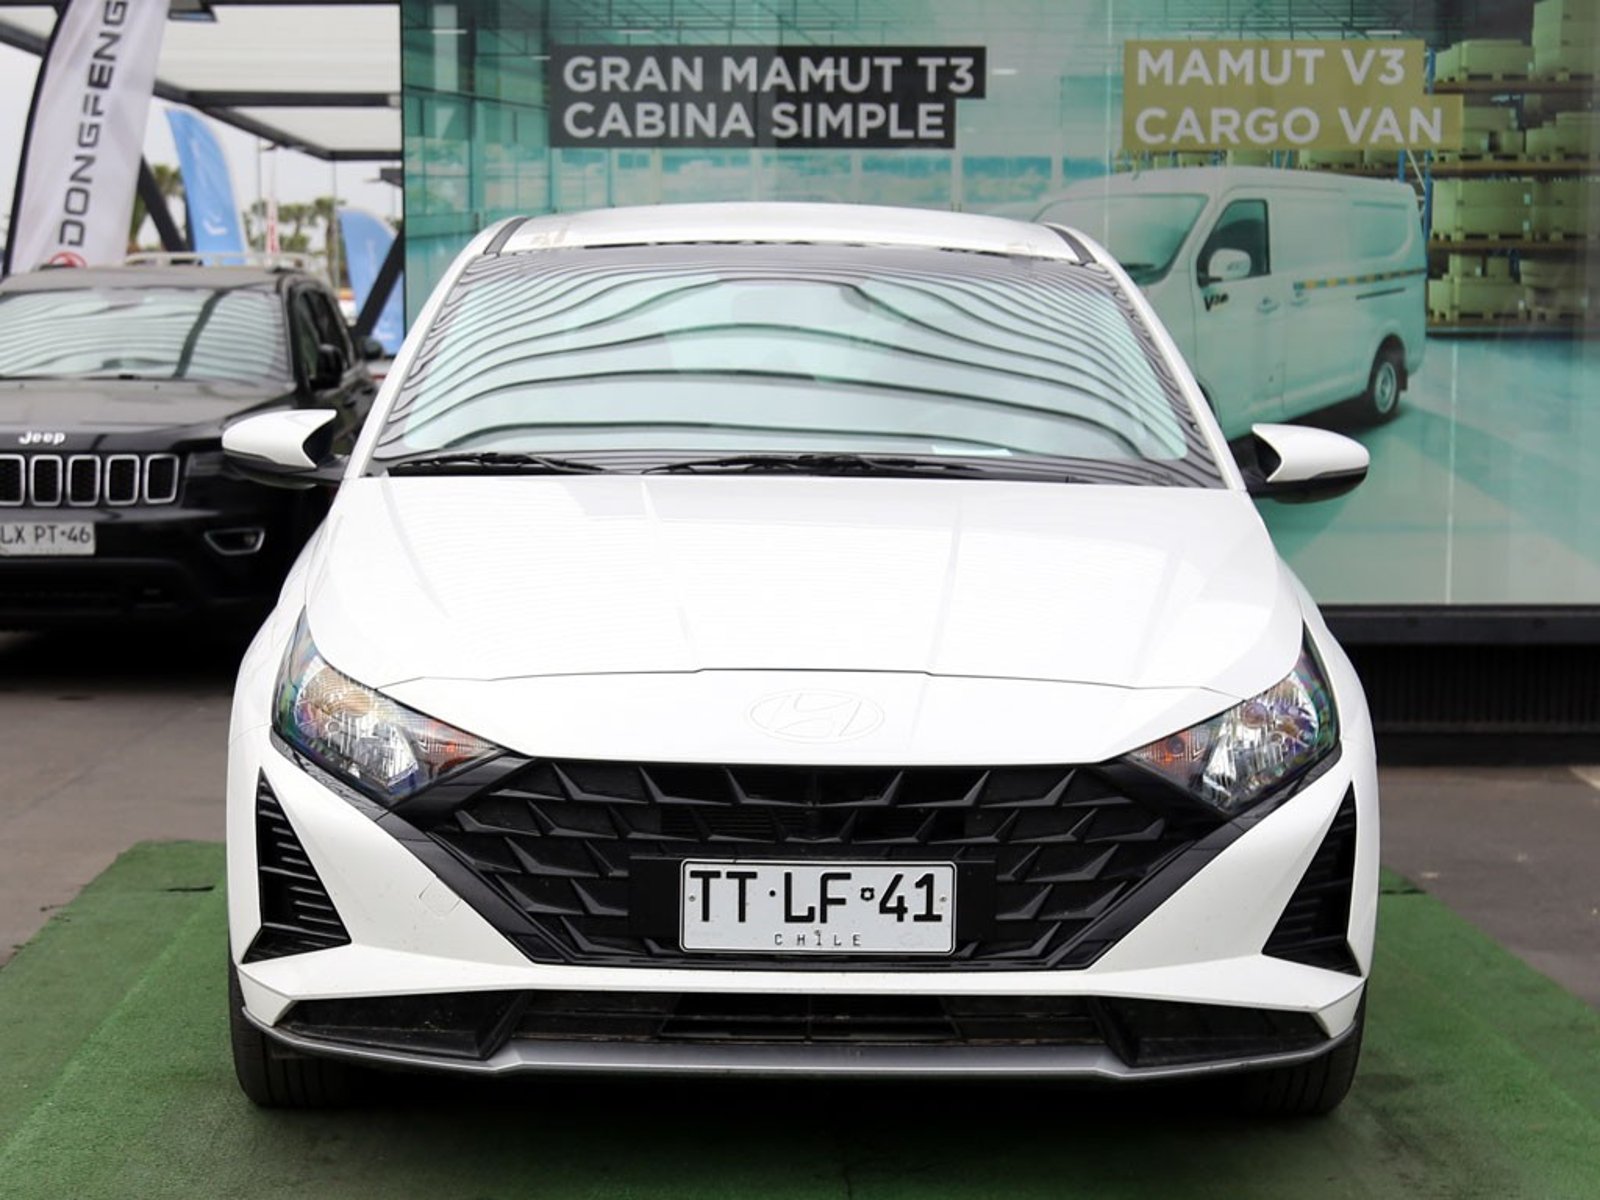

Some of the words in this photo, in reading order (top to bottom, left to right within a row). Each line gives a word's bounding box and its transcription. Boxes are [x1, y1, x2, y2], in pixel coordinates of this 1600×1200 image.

[563, 56, 703, 93] GRAN
[722, 56, 902, 93] MAMUT
[917, 57, 975, 93] T3
[1136, 48, 1325, 86] MAMUT
[1341, 48, 1406, 86] V3
[59, 0, 128, 247] DONGFENG
[562, 102, 755, 140] CABINA
[770, 102, 946, 140] SIMPLE
[1135, 107, 1321, 145] CARGO
[1338, 107, 1443, 144] VAN
[18, 431, 66, 445] Jeep
[773, 932, 862, 947] CHILE
